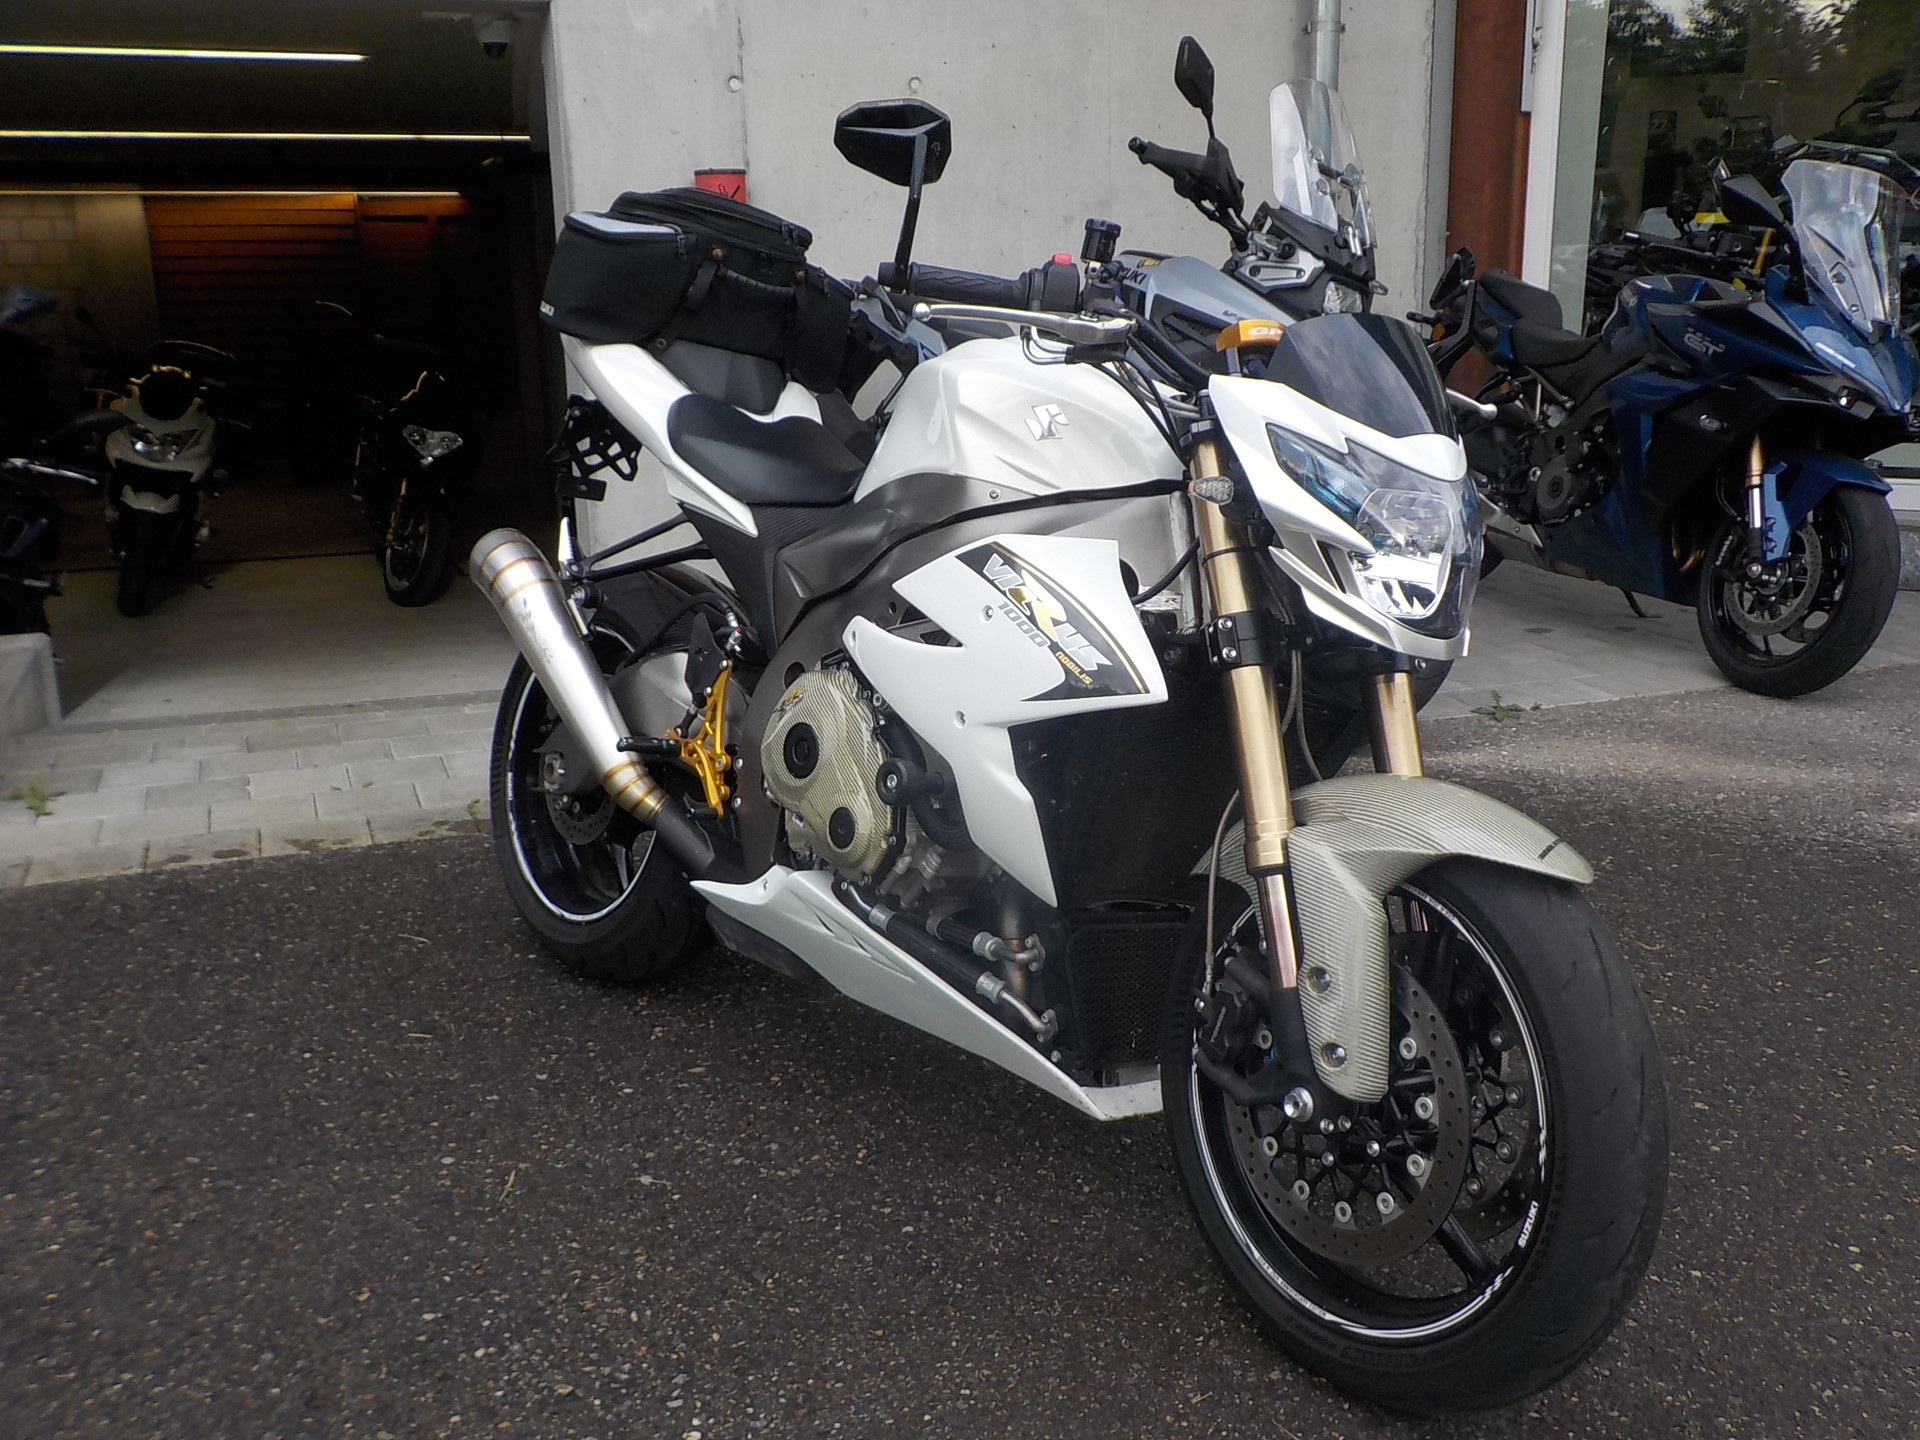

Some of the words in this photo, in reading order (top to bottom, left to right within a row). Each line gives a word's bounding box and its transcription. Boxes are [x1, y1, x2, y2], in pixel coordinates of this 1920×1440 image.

[996, 600, 1050, 648] 1000
[1055, 650, 1094, 685] NOBILIS
[1517, 1200, 1539, 1248] SUZUKI
